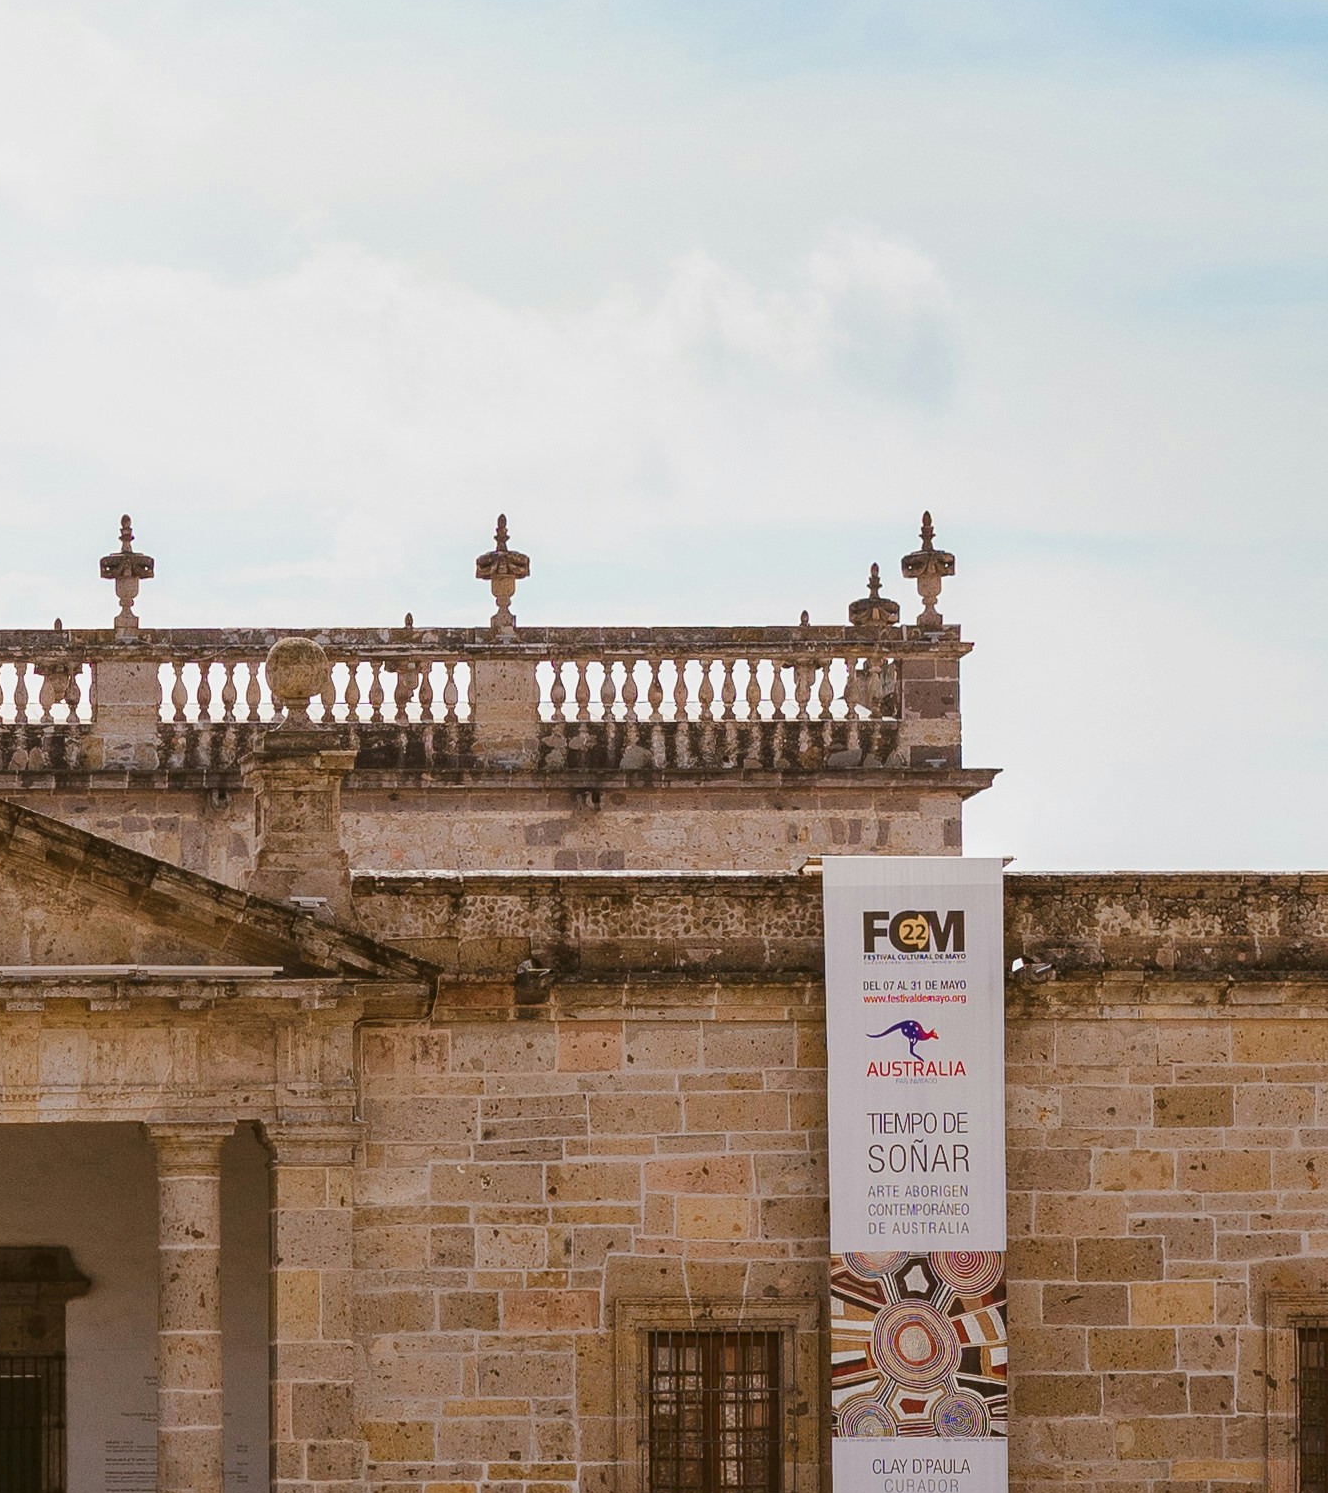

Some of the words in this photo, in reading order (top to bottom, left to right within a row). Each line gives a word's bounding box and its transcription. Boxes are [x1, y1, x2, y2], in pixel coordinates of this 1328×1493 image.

[902, 924, 927, 941] 22
[863, 953, 896, 961] FESTIVAL
[897, 953, 933, 961] CULTURAL
[863, 981, 881, 991] DEL
[883, 981, 895, 991] 07
[897, 980, 908, 990] AL
[910, 980, 921, 990] 31
[925, 980, 937, 990] DE
[940, 980, 966, 990] MAYO
[863, 993, 967, 1004] www.festivaldemayo.org
[866, 1061, 967, 1077] AUSTRALIA
[866, 1111, 938, 1135] TIEMPO
[943, 1111, 969, 1134] DE
[868, 1138, 970, 1173] SOÑAR
[867, 1185, 900, 1198] ARTE
[905, 1185, 969, 1198] ABORIGEN
[868, 1200, 970, 1216] CONTEMPORÁNEO
[868, 1222, 886, 1235] DE
[892, 1221, 970, 1235] AUSTRALIA
[872, 1459, 908, 1474] CLAY
[884, 1478, 959, 1493] CURADOR
